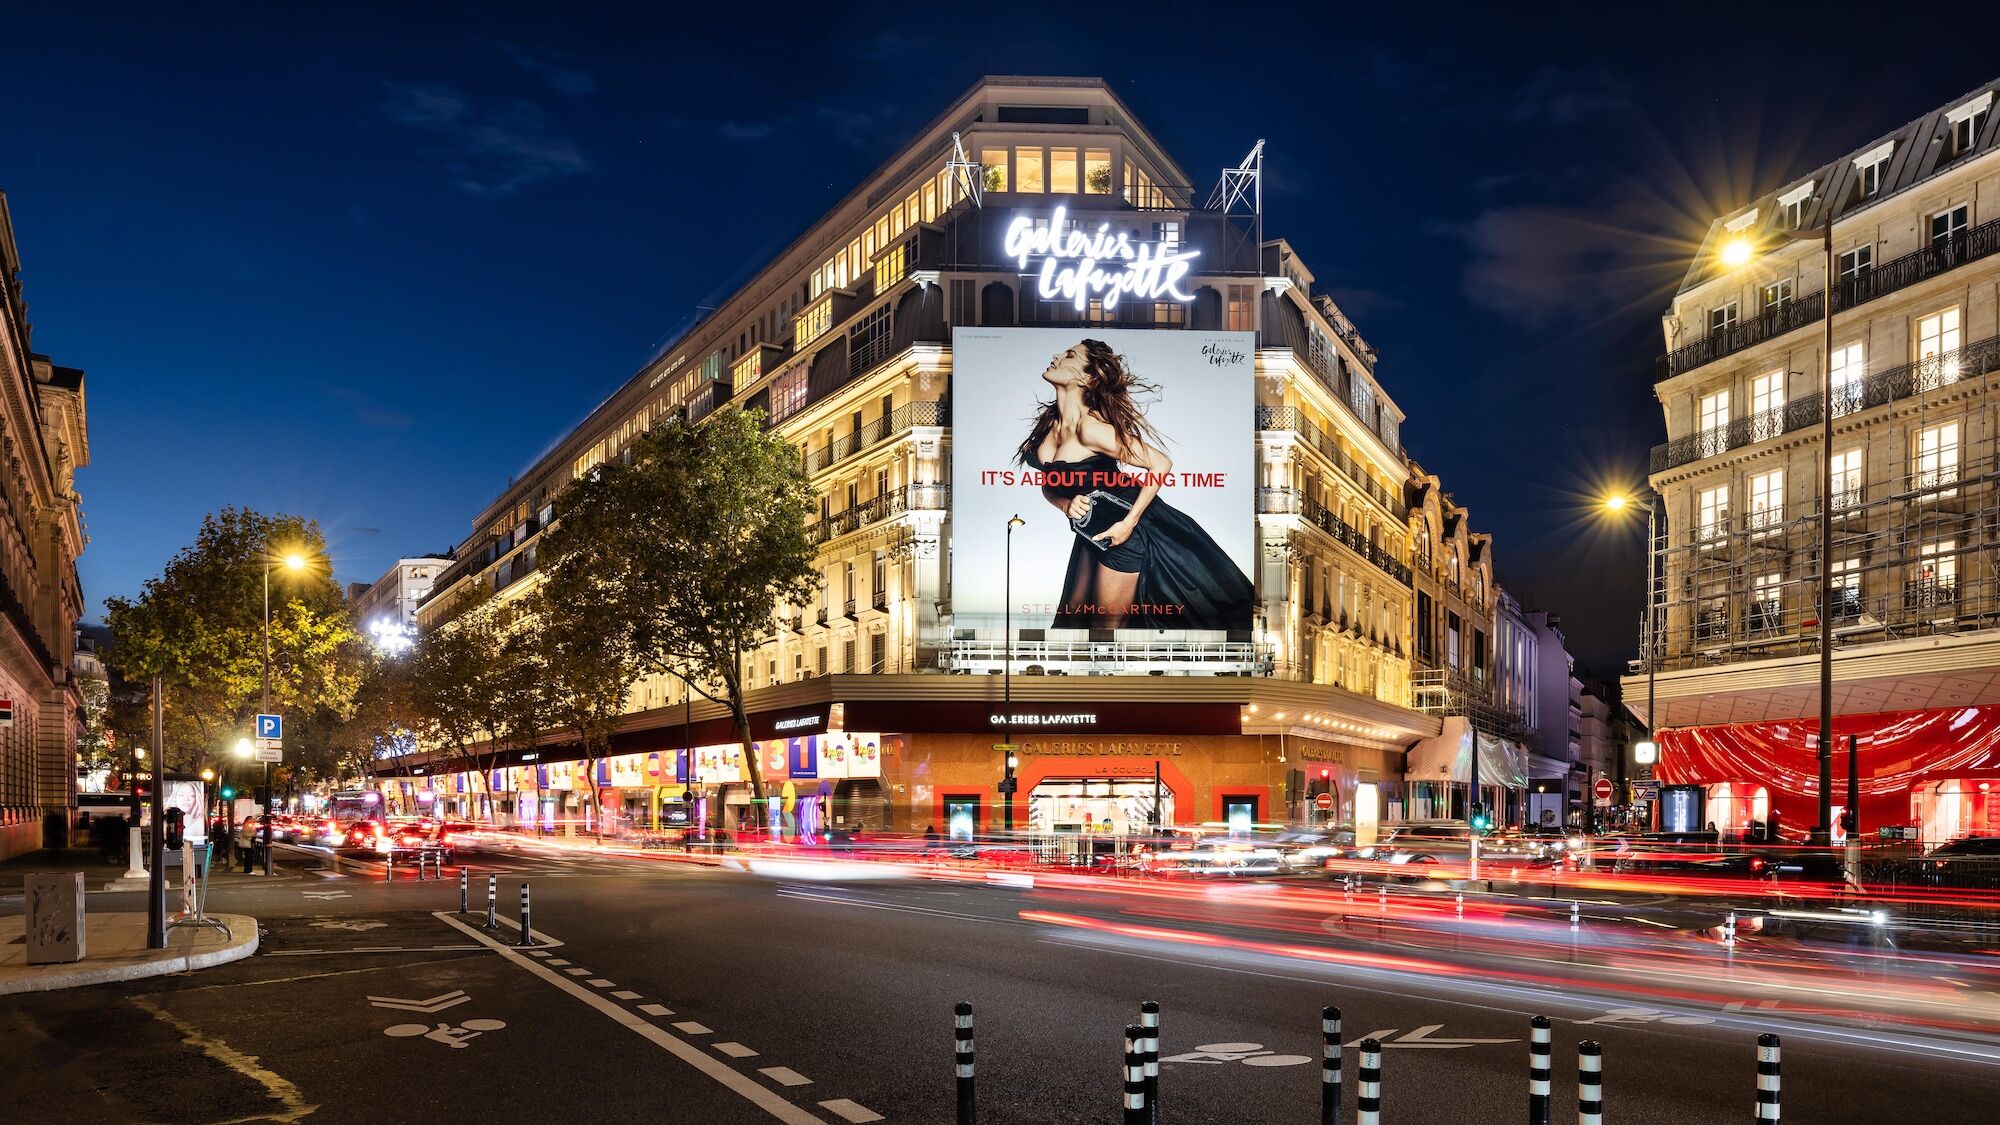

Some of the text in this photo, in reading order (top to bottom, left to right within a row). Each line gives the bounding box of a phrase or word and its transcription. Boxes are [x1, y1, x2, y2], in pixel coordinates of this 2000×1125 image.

[1005, 205, 1135, 269] Galeries
[1038, 242, 1201, 311] Lafayette
[981, 471, 1014, 486] IT'S
[1020, 471, 1087, 487] ABOUT
[1092, 471, 1176, 488] FUCKING
[263, 718, 276, 735] P
[775, 715, 820, 730] GALERIES LAFAYETTE
[990, 714, 1097, 725] GAERIES LAFAYETTE
[1022, 742, 1094, 756] GALERIES
[1099, 742, 1182, 756] LAFAYETTE
